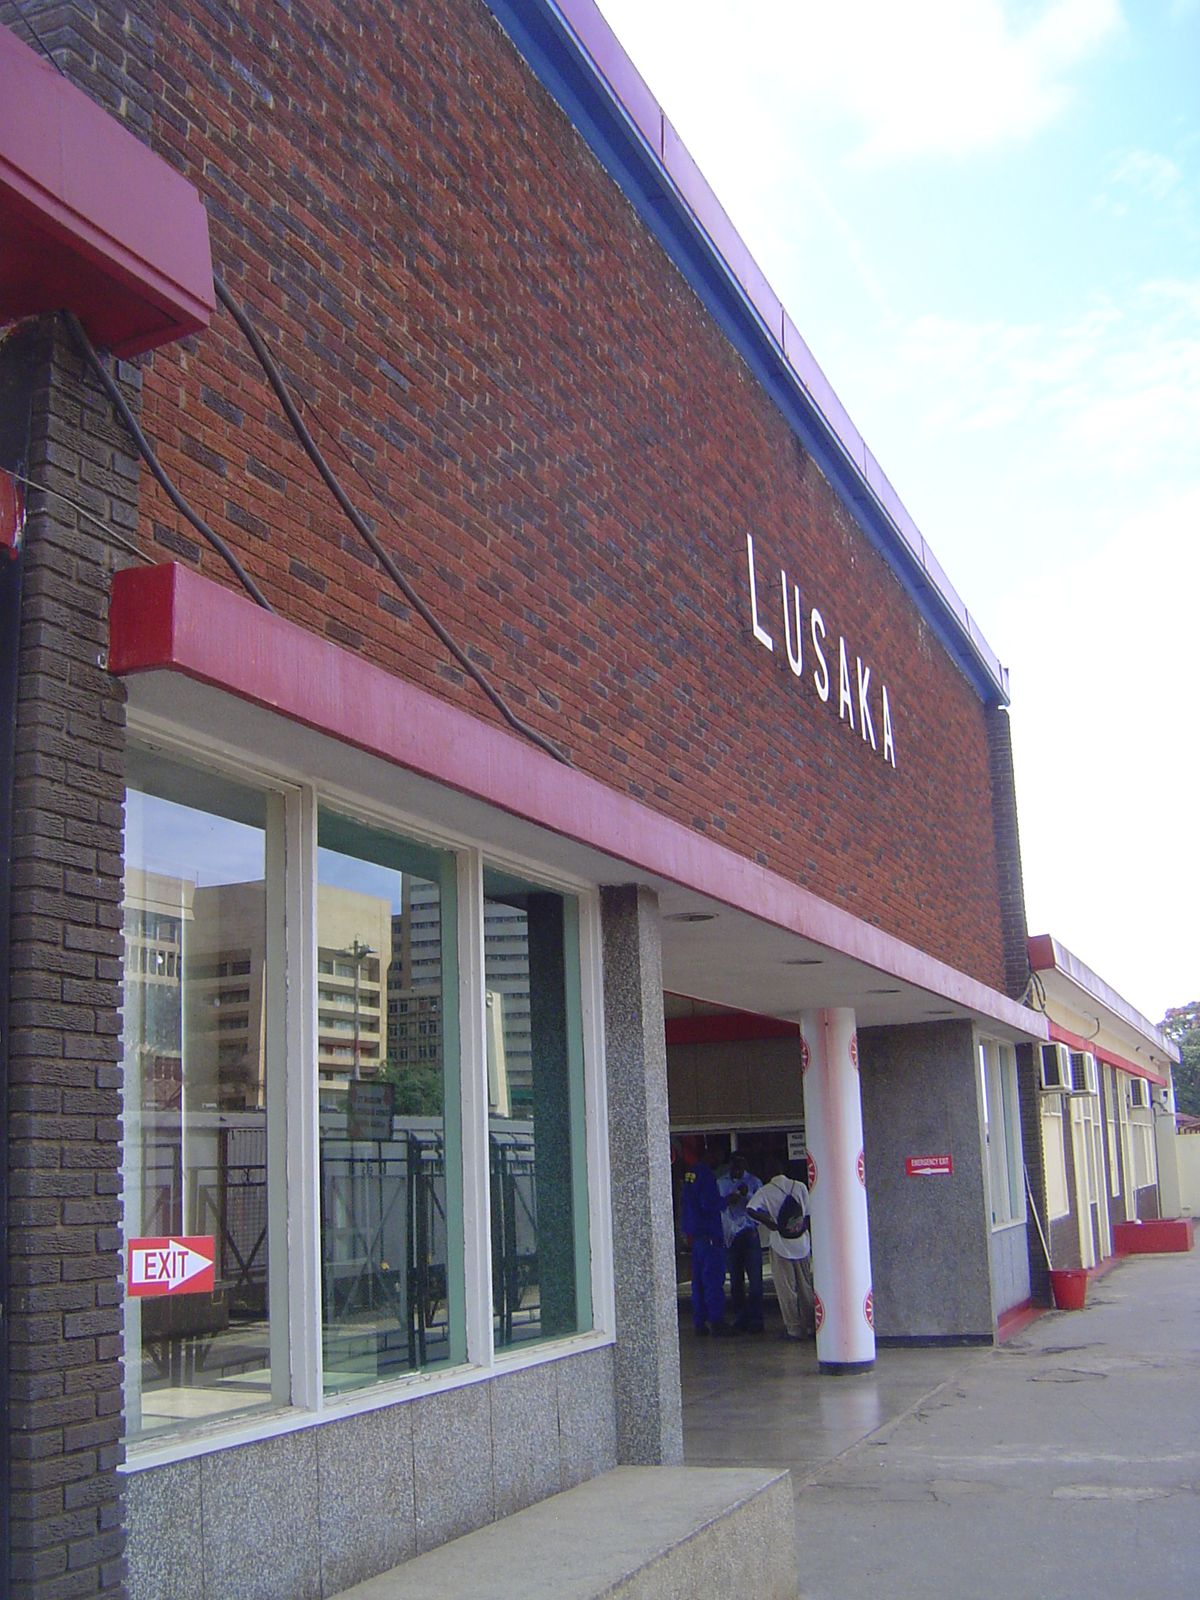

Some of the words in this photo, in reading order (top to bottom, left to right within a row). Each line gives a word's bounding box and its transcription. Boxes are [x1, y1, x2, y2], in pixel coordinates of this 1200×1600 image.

[746, 532, 896, 768] LUSAKA
[911, 1158, 938, 1167] EMERGENCY
[938, 1156, 949, 1166] EXIT
[144, 1250, 189, 1280] EXIT
